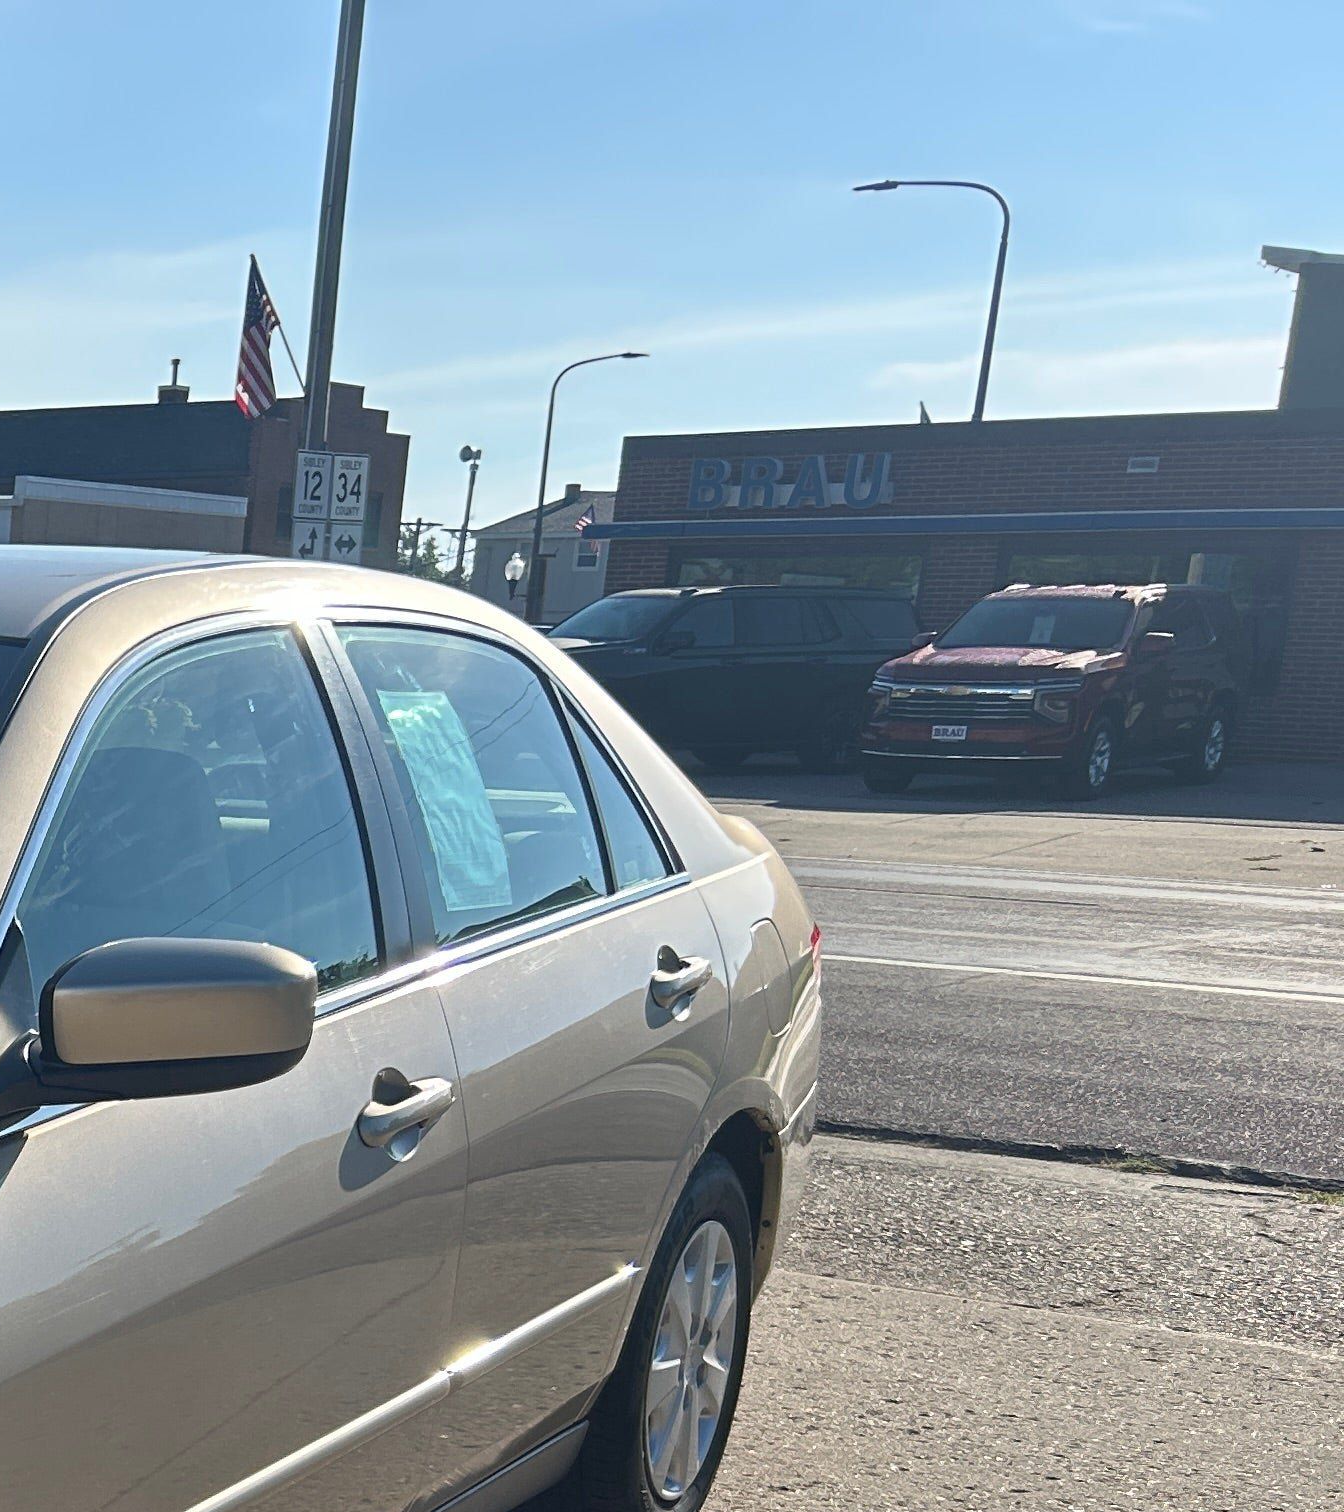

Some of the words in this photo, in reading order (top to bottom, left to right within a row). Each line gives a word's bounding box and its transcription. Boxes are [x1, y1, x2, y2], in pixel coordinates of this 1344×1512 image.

[304, 457, 325, 468] SIBLEY
[340, 460, 362, 470] SIBLEY
[303, 470, 323, 501] 12
[687, 453, 890, 510] BRAU
[336, 473, 361, 503] 34
[298, 504, 323, 514] COUNTY
[335, 506, 360, 517] COUNTY
[934, 727, 965, 737] BRAU
